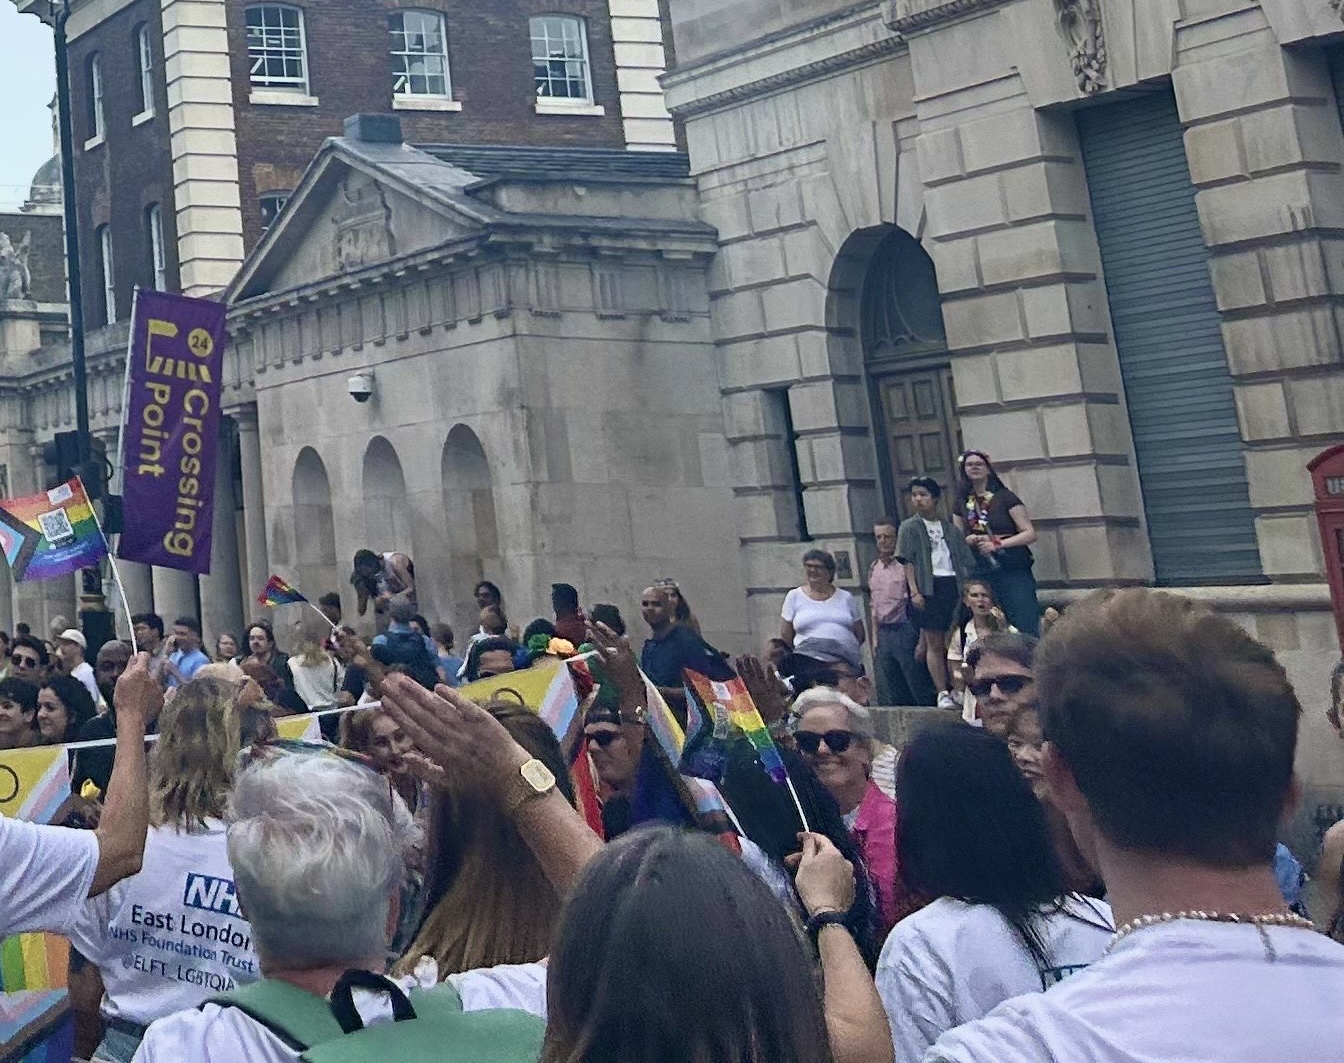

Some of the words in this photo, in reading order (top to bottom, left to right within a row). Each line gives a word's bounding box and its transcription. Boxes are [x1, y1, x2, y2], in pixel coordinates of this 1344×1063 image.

[191, 335, 209, 350] 24
[138, 381, 172, 478] Point
[163, 388, 210, 558] Crossing
[132, 904, 174, 932] East
[220, 950, 254, 973] Trust
